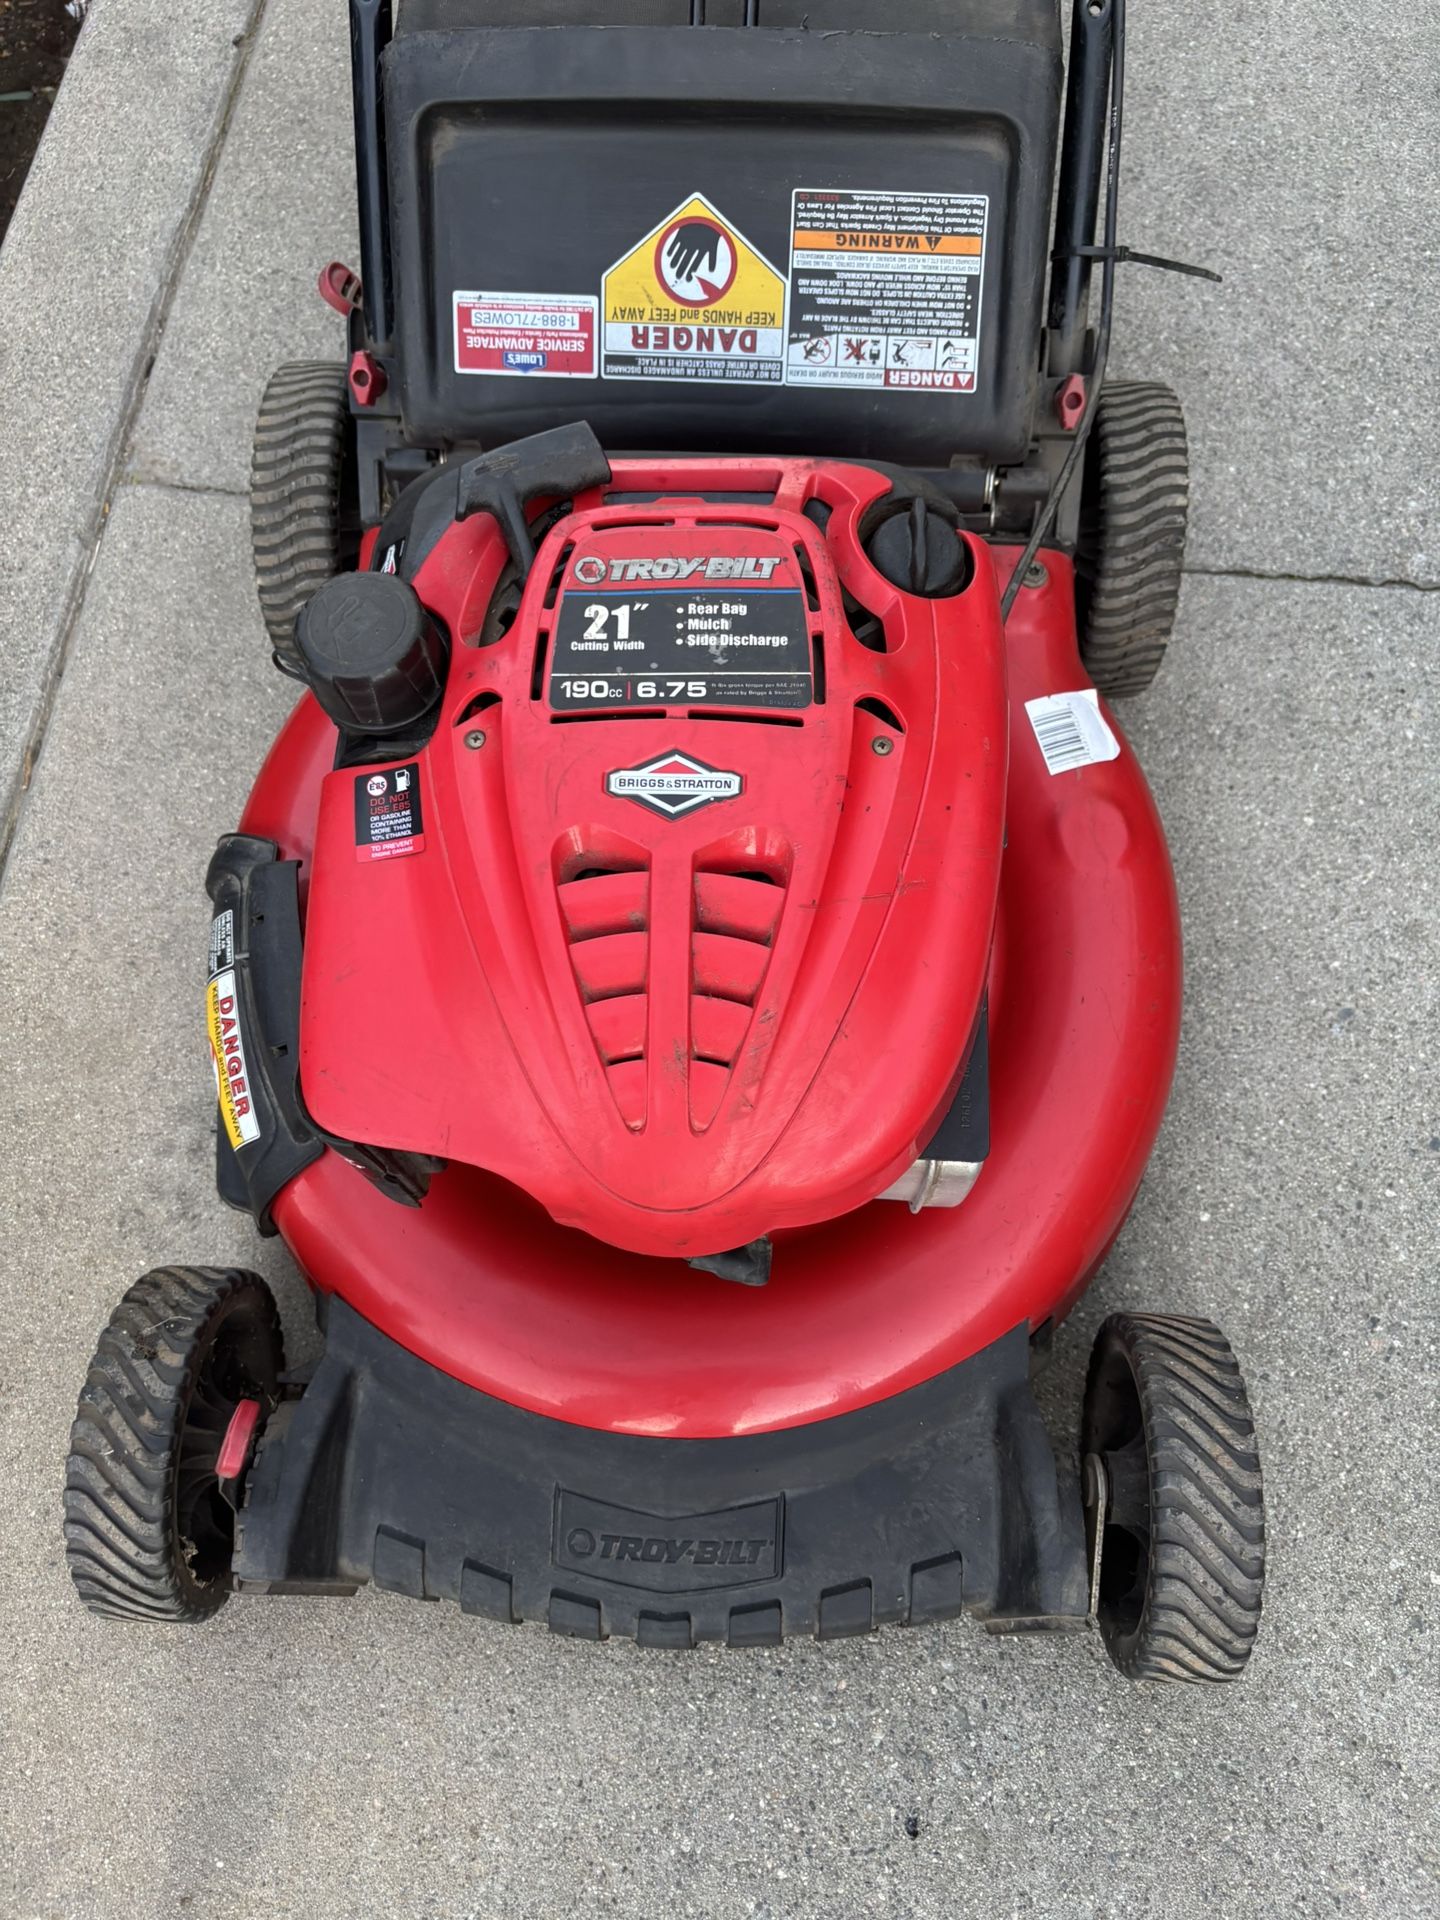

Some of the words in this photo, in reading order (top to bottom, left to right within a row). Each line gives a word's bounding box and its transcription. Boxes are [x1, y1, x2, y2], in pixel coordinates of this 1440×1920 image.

[851, 193, 894, 202] Requirements.
[950, 197, 985, 205] Regulations
[836, 202, 863, 210] Agencies
[944, 206, 971, 214] Operator
[796, 210, 825, 219] Required.
[875, 213, 892, 221] Spark
[899, 214, 932, 222] Vegetation.
[933, 215, 944, 223] Dry
[840, 221, 860, 229] Sparks
[897, 223, 928, 232] Equipment
[952, 225, 982, 233] Operation
[835, 233, 919, 248] WARNING
[611, 306, 644, 320] AWAY
[648, 308, 676, 321] FEET
[680, 309, 698, 322] and
[702, 309, 741, 324] HANDS
[745, 311, 775, 325] KEEP
[474, 312, 575, 327] 1-888-77LOWES
[466, 336, 533, 349] ADVANTAGE
[536, 338, 584, 351] SERVICE
[631, 325, 757, 353] DANGER
[506, 353, 542, 365] LOWE'S
[635, 358, 656, 366] PLACE.
[659, 358, 665, 366] IN
[675, 359, 703, 367] CATCHER
[705, 360, 724, 368] GRASS
[606, 365, 641, 374] DISCHARGE
[643, 366, 684, 375] UNDAMAGED
[726, 361, 747, 369] ENTIRE
[748, 361, 758, 369] OR
[759, 362, 780, 370] COVER
[686, 368, 695, 376] AN
[697, 368, 723, 377] UNLESS
[724, 369, 754, 378] OPERATE
[756, 370, 768, 378] NOT
[888, 371, 952, 386] DANGER
[608, 557, 781, 581] TROY-BILT
[688, 603, 719, 614] Rear
[722, 603, 747, 616] Bag
[583, 603, 649, 640] 21"
[688, 618, 729, 630] Mulch
[571, 642, 609, 651] Cutting
[614, 640, 644, 650] Width
[687, 634, 716, 646] Side
[720, 634, 788, 647] Discharge
[560, 680, 622, 698] 190cc
[637, 682, 707, 698] 6.75
[370, 782, 384, 791] E85
[370, 798, 384, 806] DO
[390, 792, 410, 803] NOT
[370, 806, 389, 815] USE
[393, 801, 410, 812] E85
[381, 810, 411, 820] GASOLINE
[370, 816, 412, 828] CONTAINING
[382, 840, 413, 850] PREVENT
[214, 1017, 224, 1054] HANDS
[220, 995, 250, 1118] DANGER
[218, 1057, 227, 1076] and
[222, 1078, 233, 1104] FEET
[230, 1108, 242, 1138] AWAY
[600, 1534, 768, 1565] TROY-BILT
